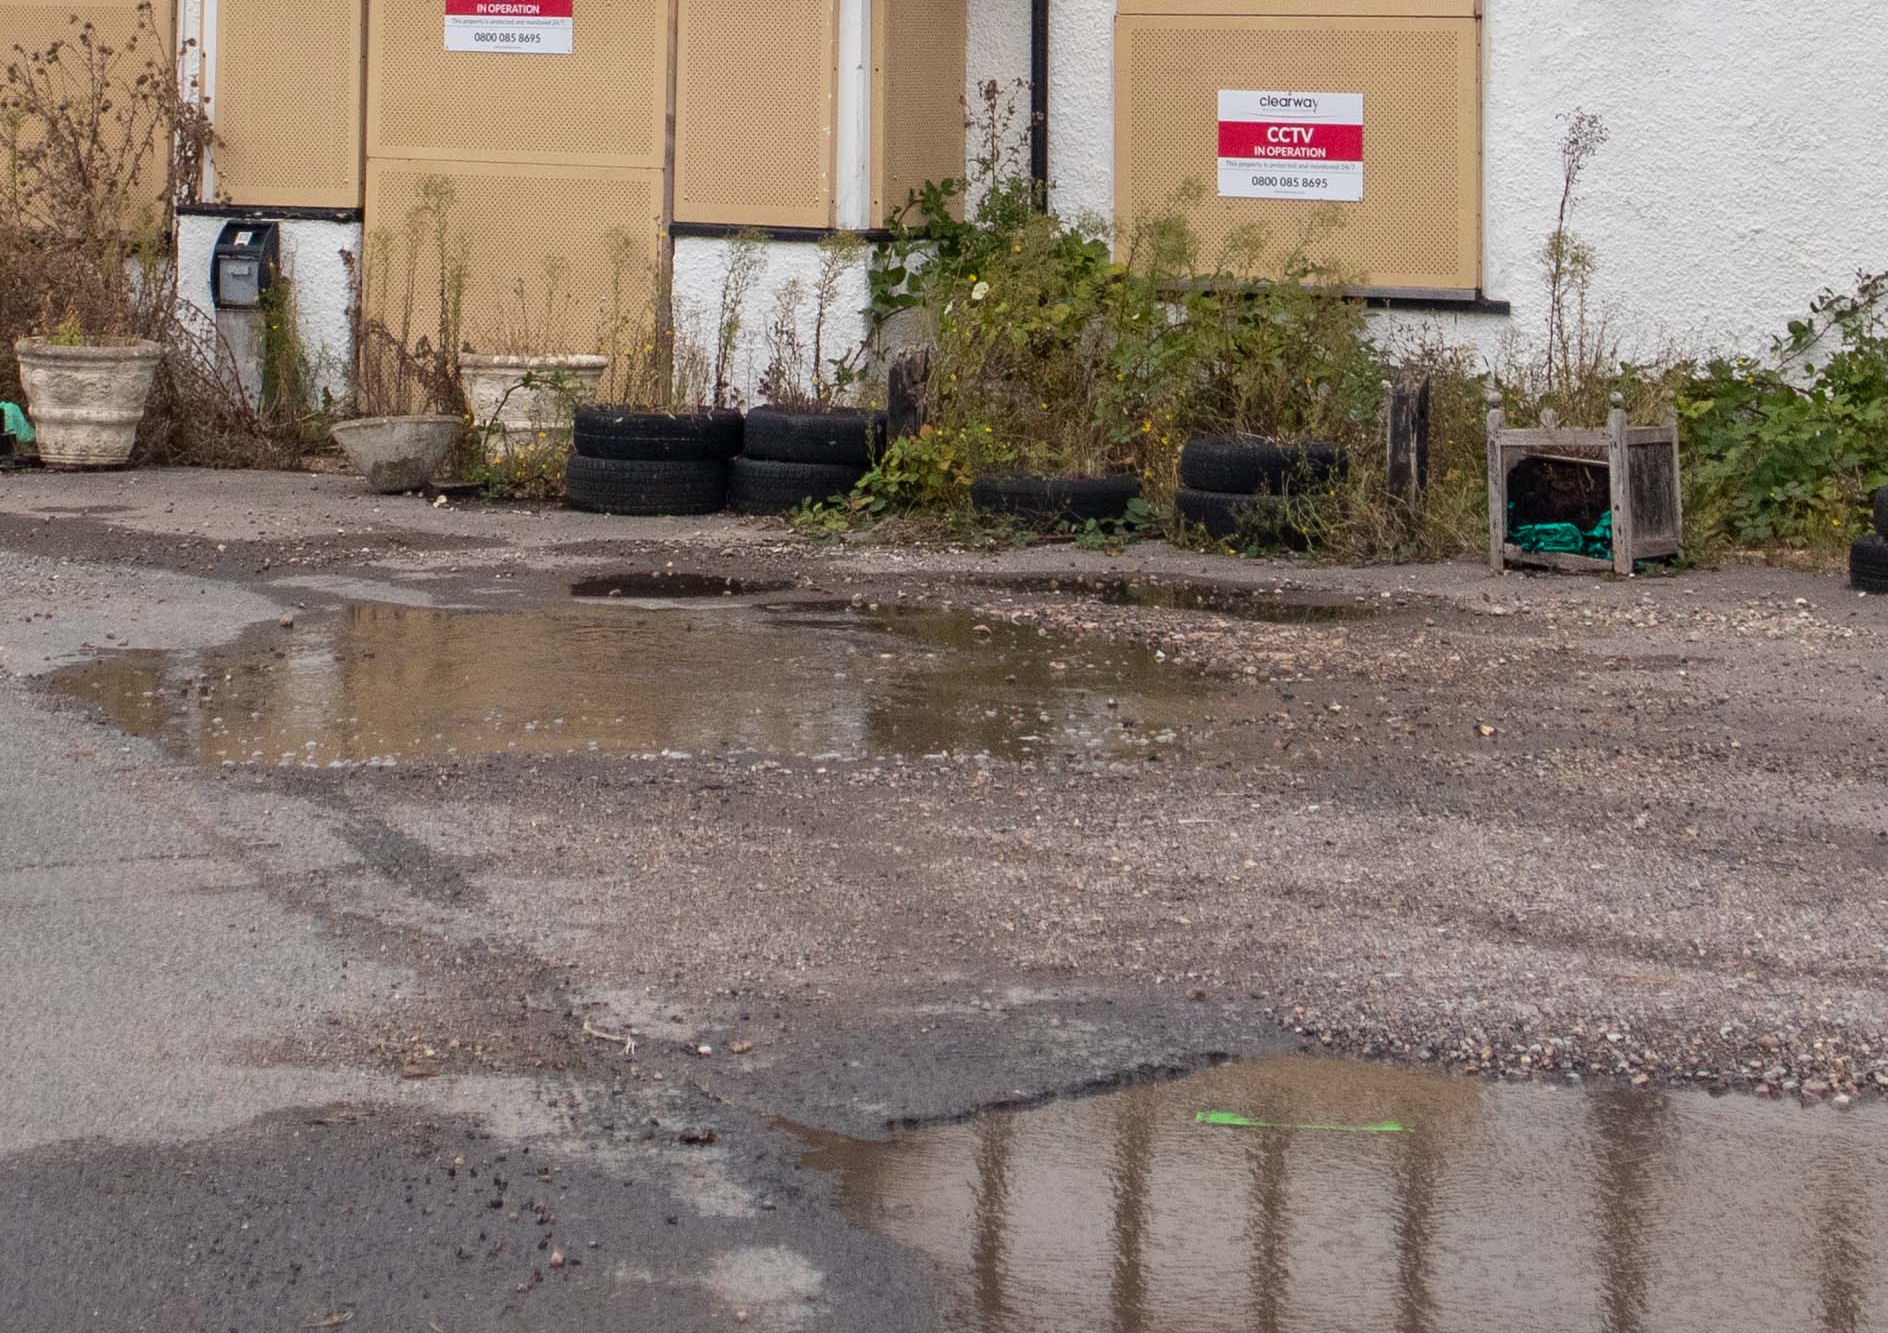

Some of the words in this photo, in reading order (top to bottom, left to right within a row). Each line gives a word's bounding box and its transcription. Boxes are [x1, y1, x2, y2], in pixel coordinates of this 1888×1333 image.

[477, 4, 486, 13] IN
[488, 4, 540, 14] OPERATION
[474, 32, 497, 43] 0800
[499, 32, 516, 43] 085
[518, 33, 541, 44] 8695
[1259, 95, 1319, 113] clearway
[1267, 126, 1314, 143] CCTV
[1254, 145, 1265, 156] IN
[1266, 146, 1326, 158] OPERATION
[1252, 175, 1278, 187] 0800
[1280, 176, 1299, 188] 085
[1302, 177, 1328, 189] 8695
